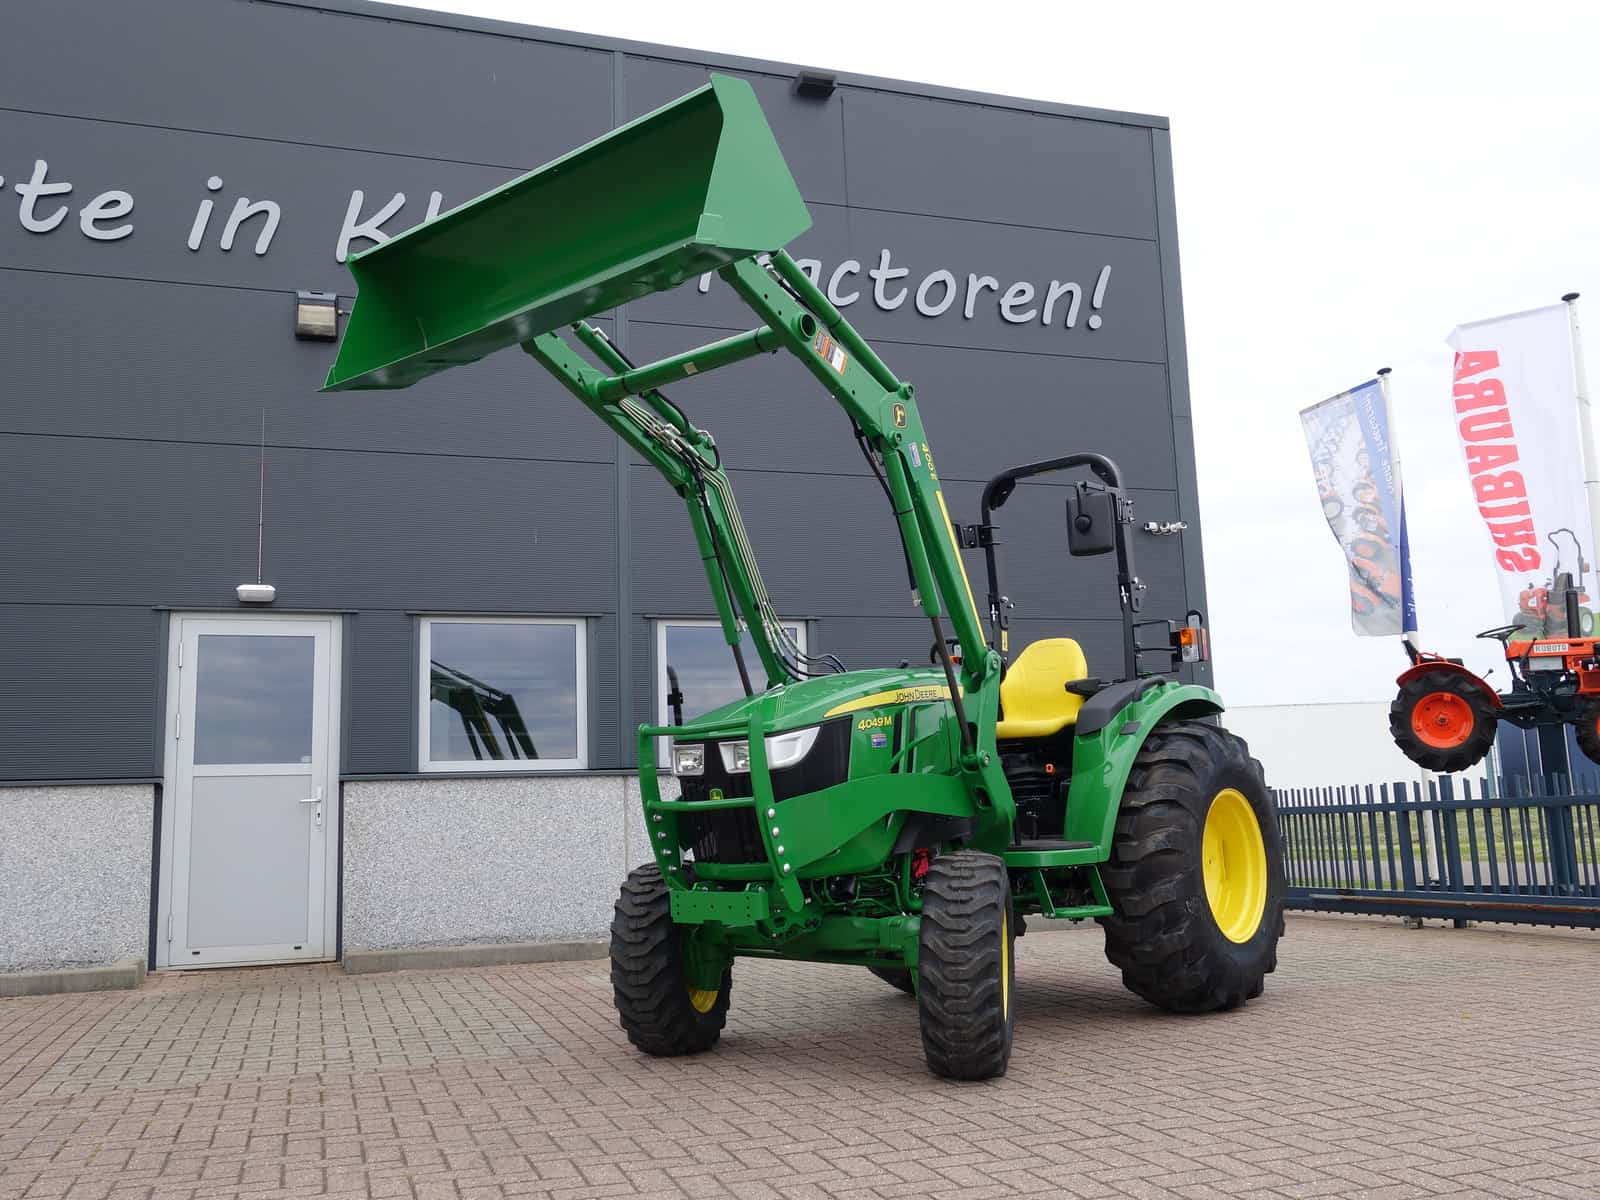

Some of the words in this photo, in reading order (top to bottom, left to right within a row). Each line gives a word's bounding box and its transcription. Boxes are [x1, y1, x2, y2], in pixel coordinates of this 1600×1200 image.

[187, 176, 281, 256] in
[915, 689, 938, 700] DEERE
[857, 716, 893, 732] 4049M
